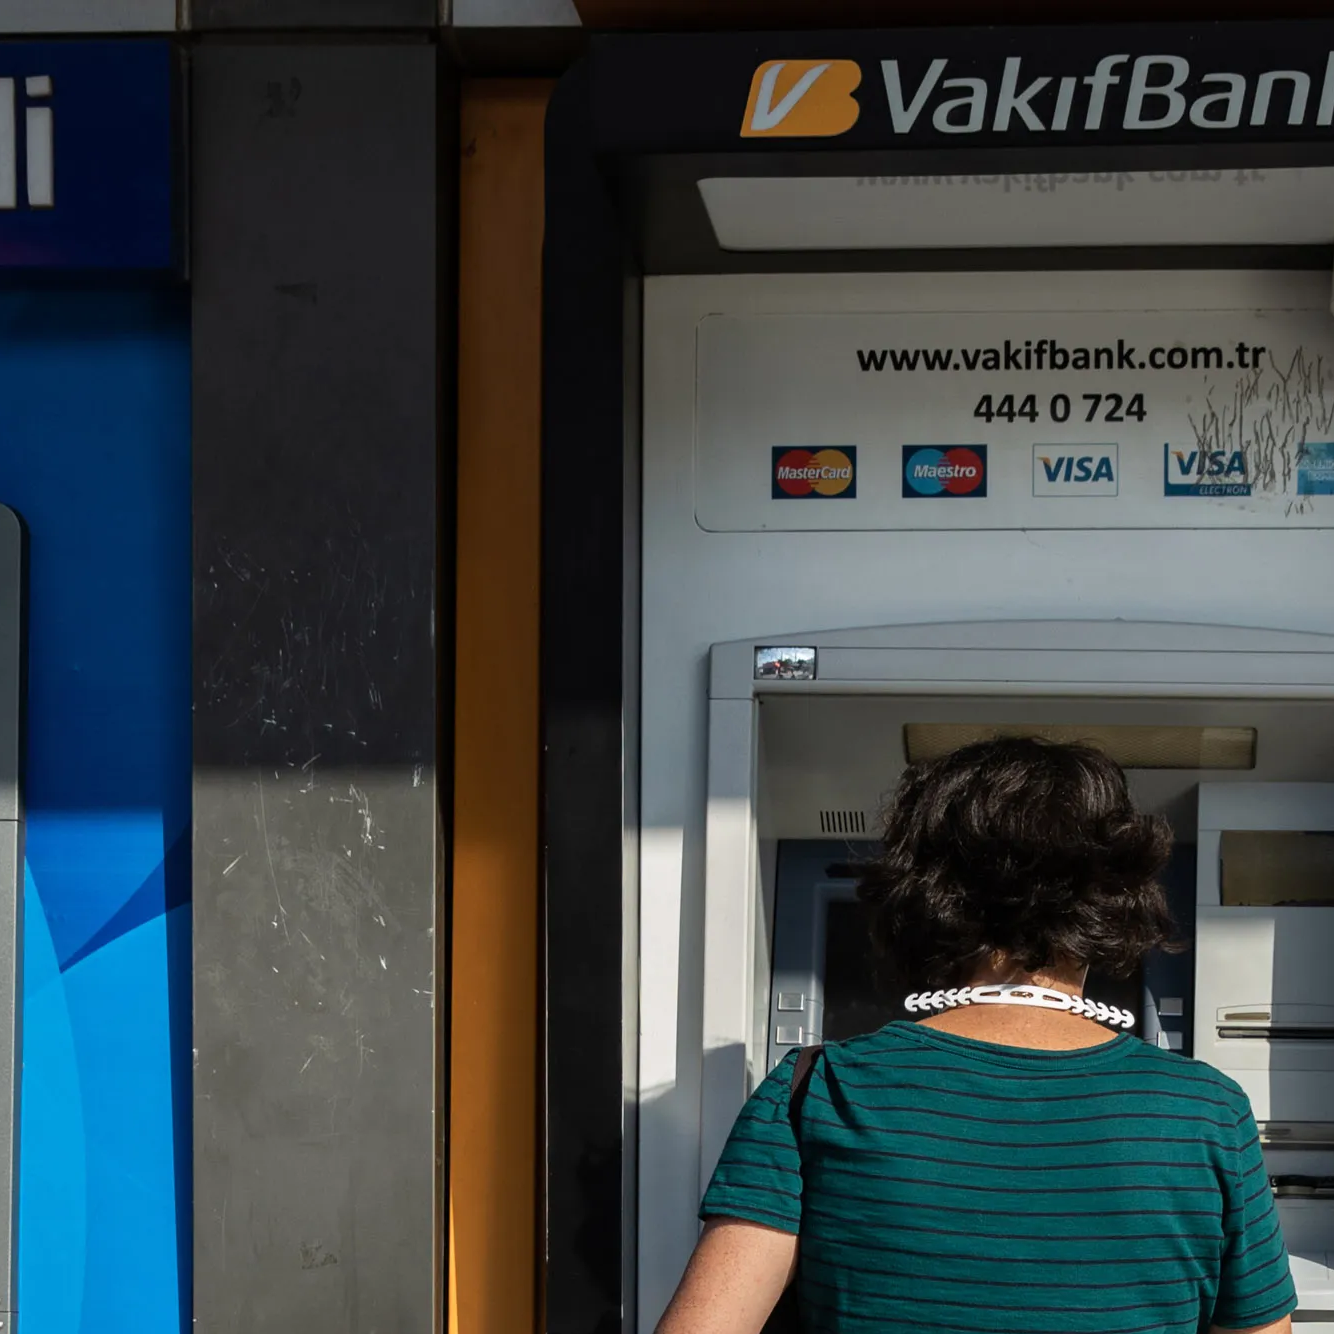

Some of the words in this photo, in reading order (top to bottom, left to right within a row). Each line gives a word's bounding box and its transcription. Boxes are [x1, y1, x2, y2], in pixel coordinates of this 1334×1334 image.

[856, 339, 1267, 372] www.vakifbank.com.tr
[973, 394, 1039, 423] 444
[1050, 393, 1071, 423] 0
[1082, 392, 1147, 422] 724
[776, 464, 852, 481] MasterCard
[913, 464, 978, 480] Maestro
[1038, 456, 1115, 483] VISA
[1171, 450, 1246, 476] VISA
[1198, 484, 1248, 496] ELECTRON
